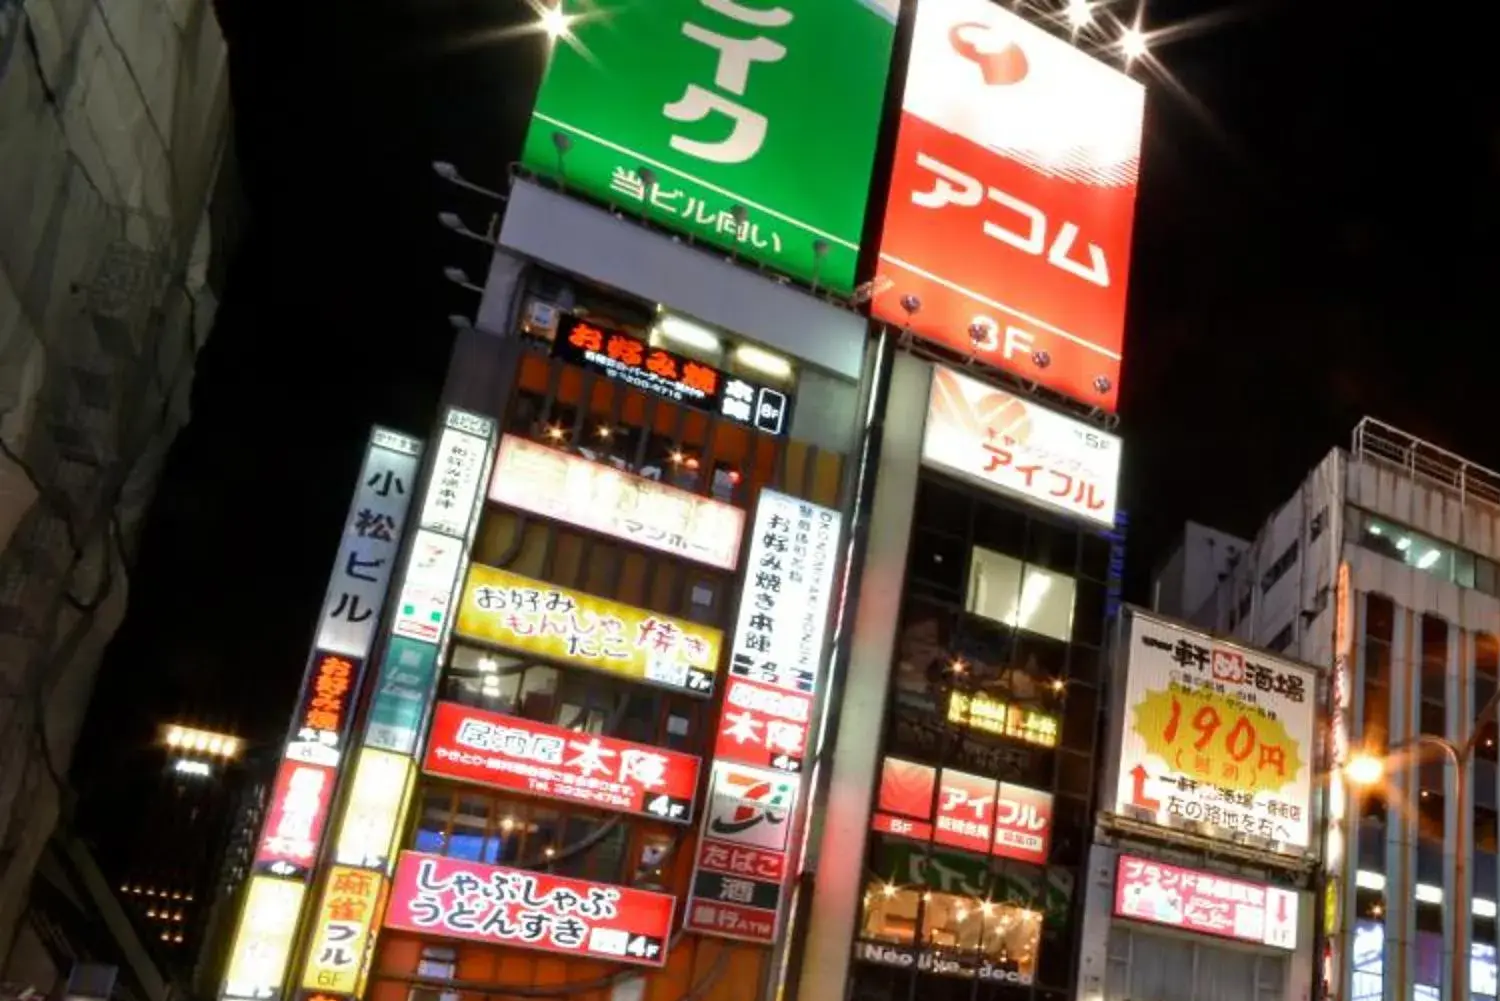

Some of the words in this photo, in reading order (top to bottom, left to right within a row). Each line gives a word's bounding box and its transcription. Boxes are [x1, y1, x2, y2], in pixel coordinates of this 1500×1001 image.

[609, 165, 782, 252] 当ビル向い
[911, 152, 1110, 288] アコム
[982, 443, 1105, 510] アイフル
[322, 469, 404, 623] 小松ビル
[477, 587, 574, 613] お好み
[568, 635, 628, 658] たこ
[1163, 695, 1285, 777] 190円
[564, 738, 669, 788] 本陣
[648, 795, 684, 817] 4F
[939, 785, 1048, 832] アイフル
[1167, 795, 1292, 841] 左の路地を右へ
[703, 845, 781, 877] たばこ
[416, 861, 617, 915] しゃぶしゃぶ
[410, 897, 587, 945] うどんすき
[627, 936, 661, 958] 4F
